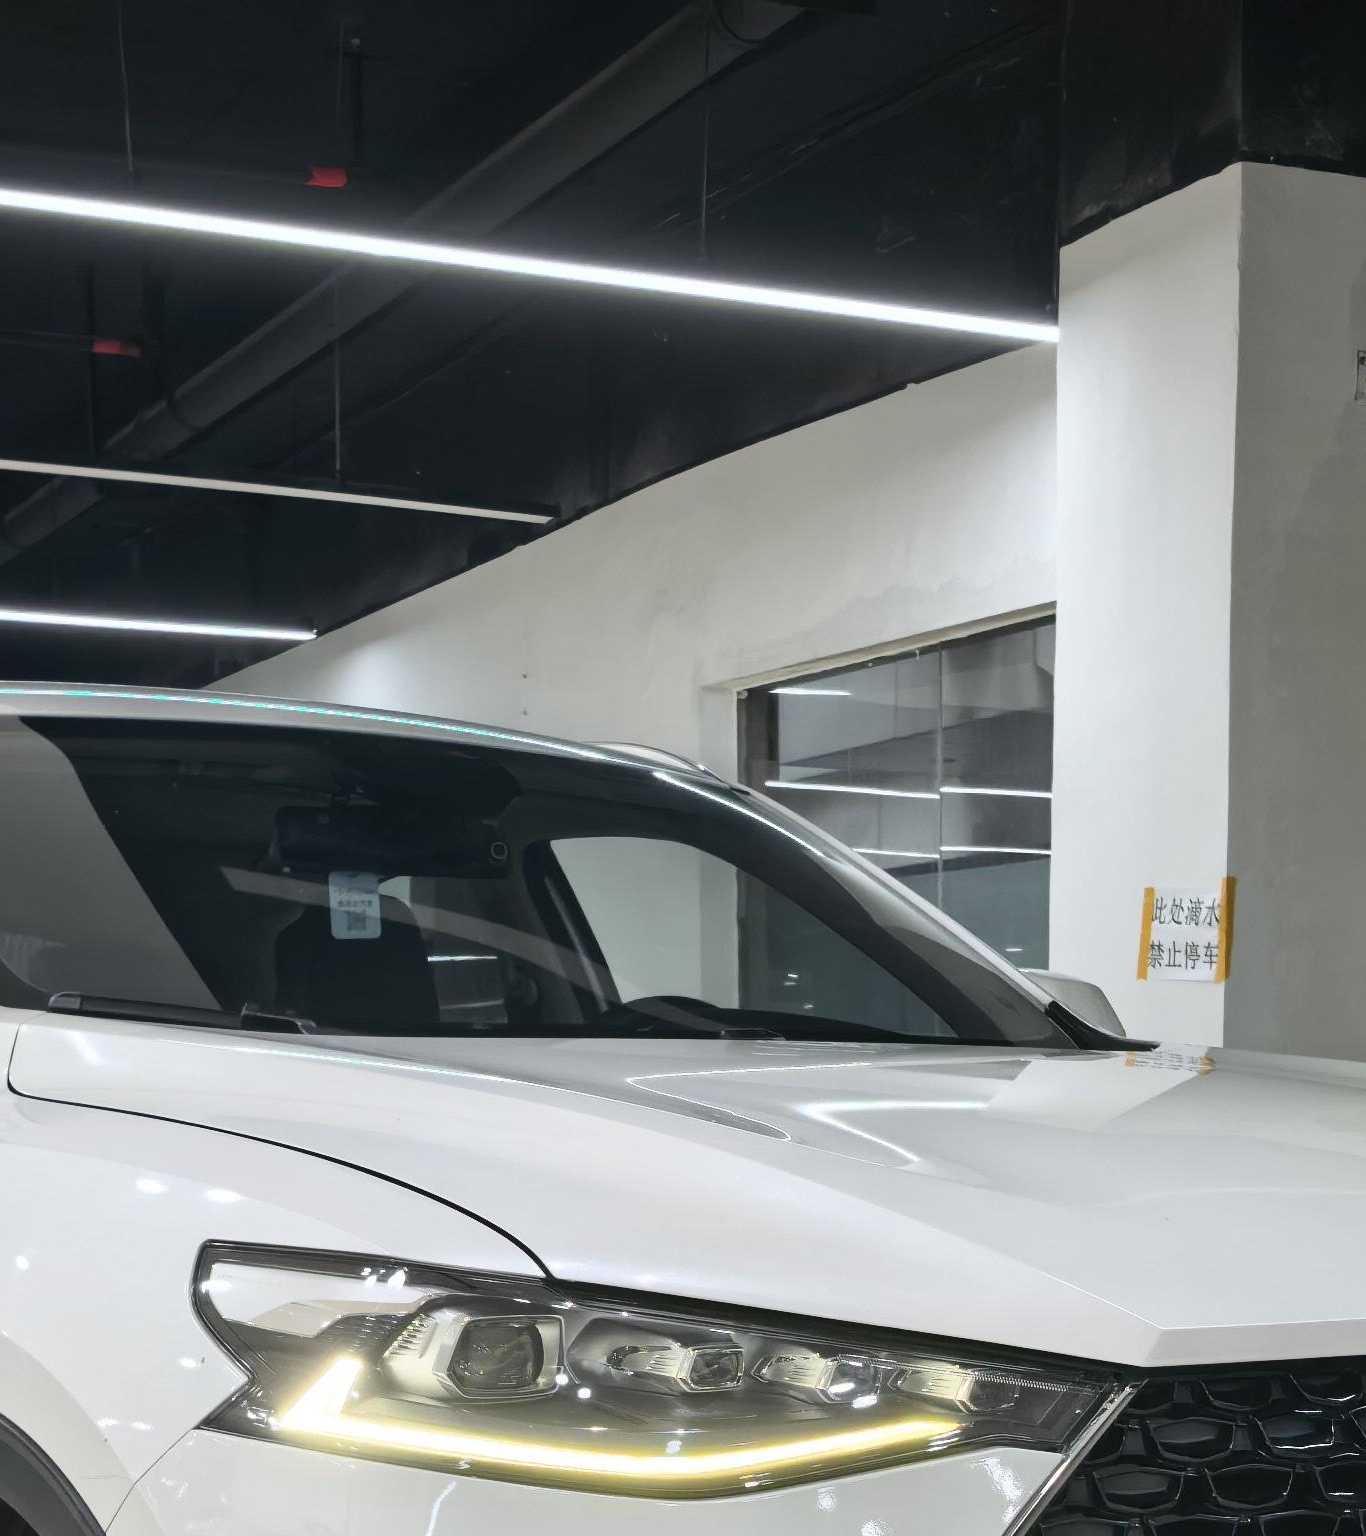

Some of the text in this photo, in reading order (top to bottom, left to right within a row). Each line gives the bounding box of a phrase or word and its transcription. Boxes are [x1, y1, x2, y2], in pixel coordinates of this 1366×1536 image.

[1152, 896, 1220, 926] 此处滴水
[1147, 940, 1219, 970] 禁止停车
